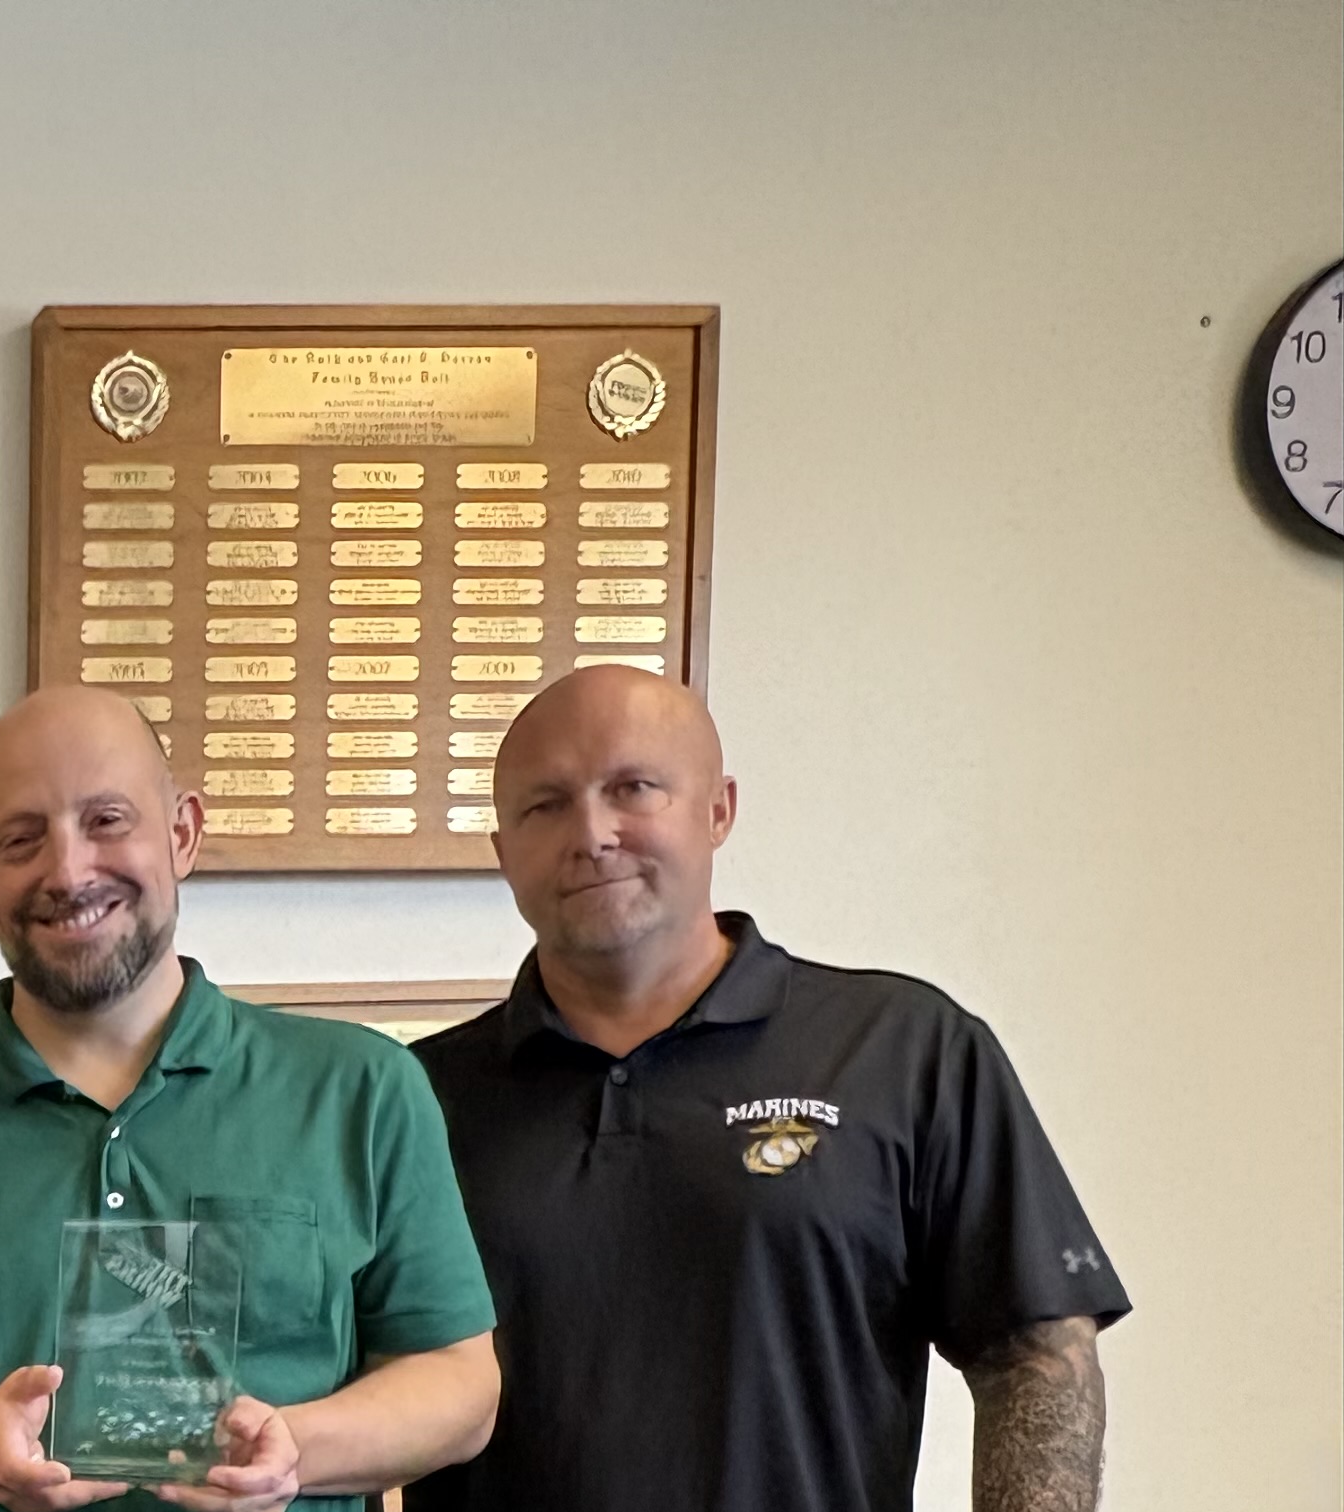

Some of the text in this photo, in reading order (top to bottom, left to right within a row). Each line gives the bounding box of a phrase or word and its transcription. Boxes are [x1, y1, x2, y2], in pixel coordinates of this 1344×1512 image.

[1332, 292, 1344, 323] 1
[1290, 331, 1326, 364] 10
[1271, 385, 1296, 419] 9
[1284, 439, 1308, 472] 8
[1322, 479, 1344, 515] 7
[725, 1097, 840, 1127] MARINES
